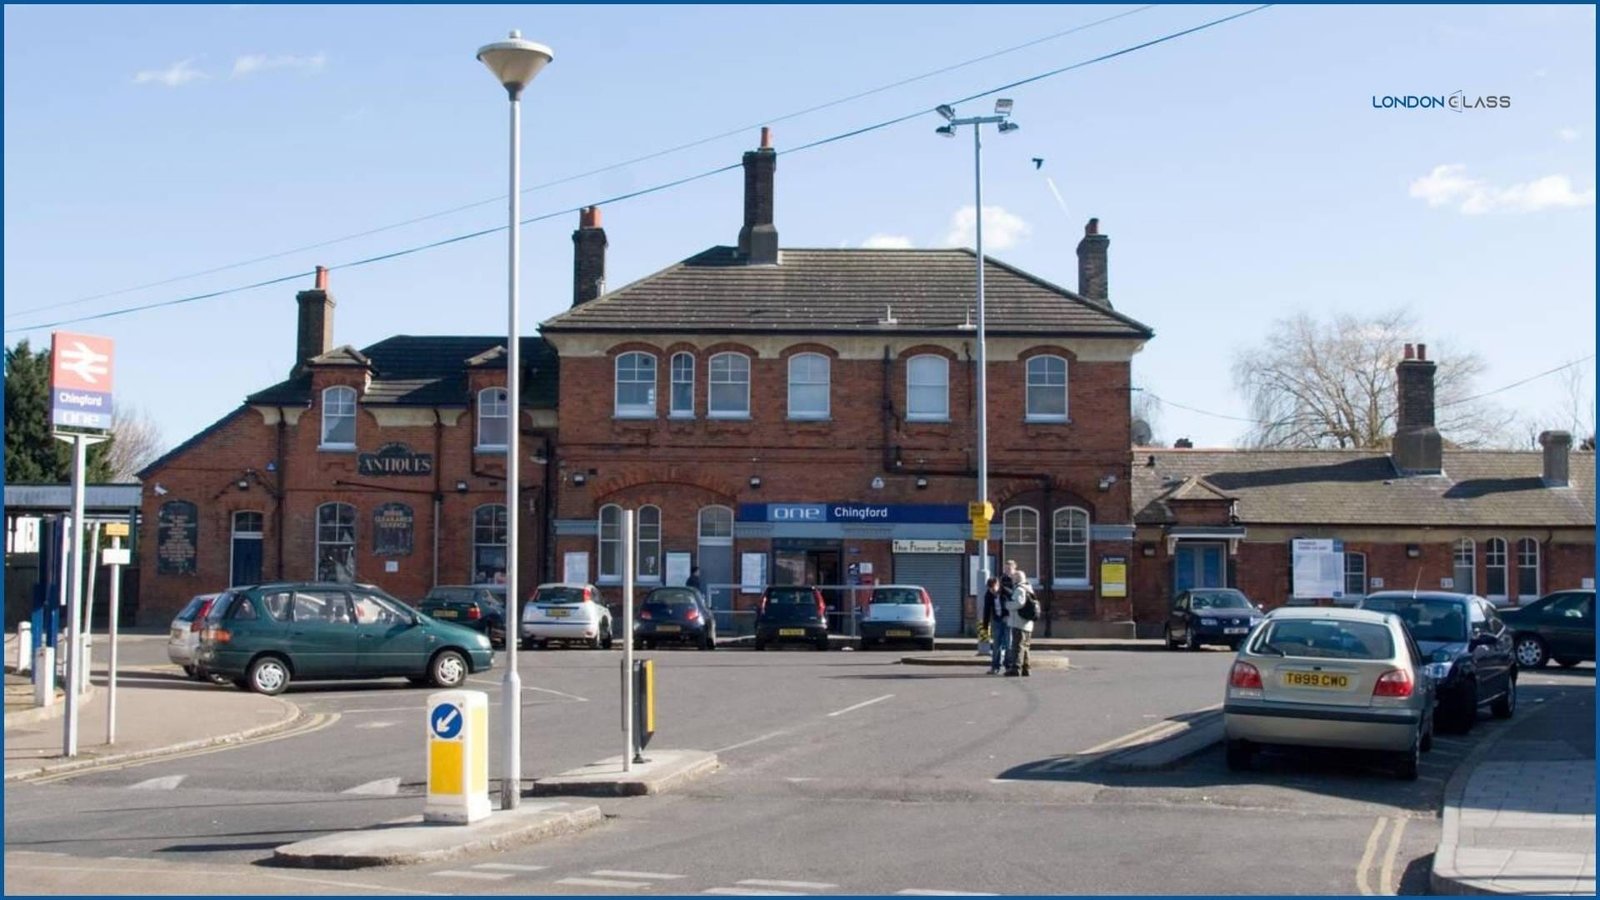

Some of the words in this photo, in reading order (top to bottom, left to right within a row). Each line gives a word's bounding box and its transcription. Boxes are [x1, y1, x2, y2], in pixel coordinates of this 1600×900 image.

[60, 392, 102, 406] Chingford
[365, 458, 431, 473] ANTIQUES
[773, 507, 820, 520] one
[834, 506, 888, 519] Chingford
[894, 541, 908, 552] The
[1287, 673, 1319, 685] T899
[1321, 675, 1348, 687] CWO
